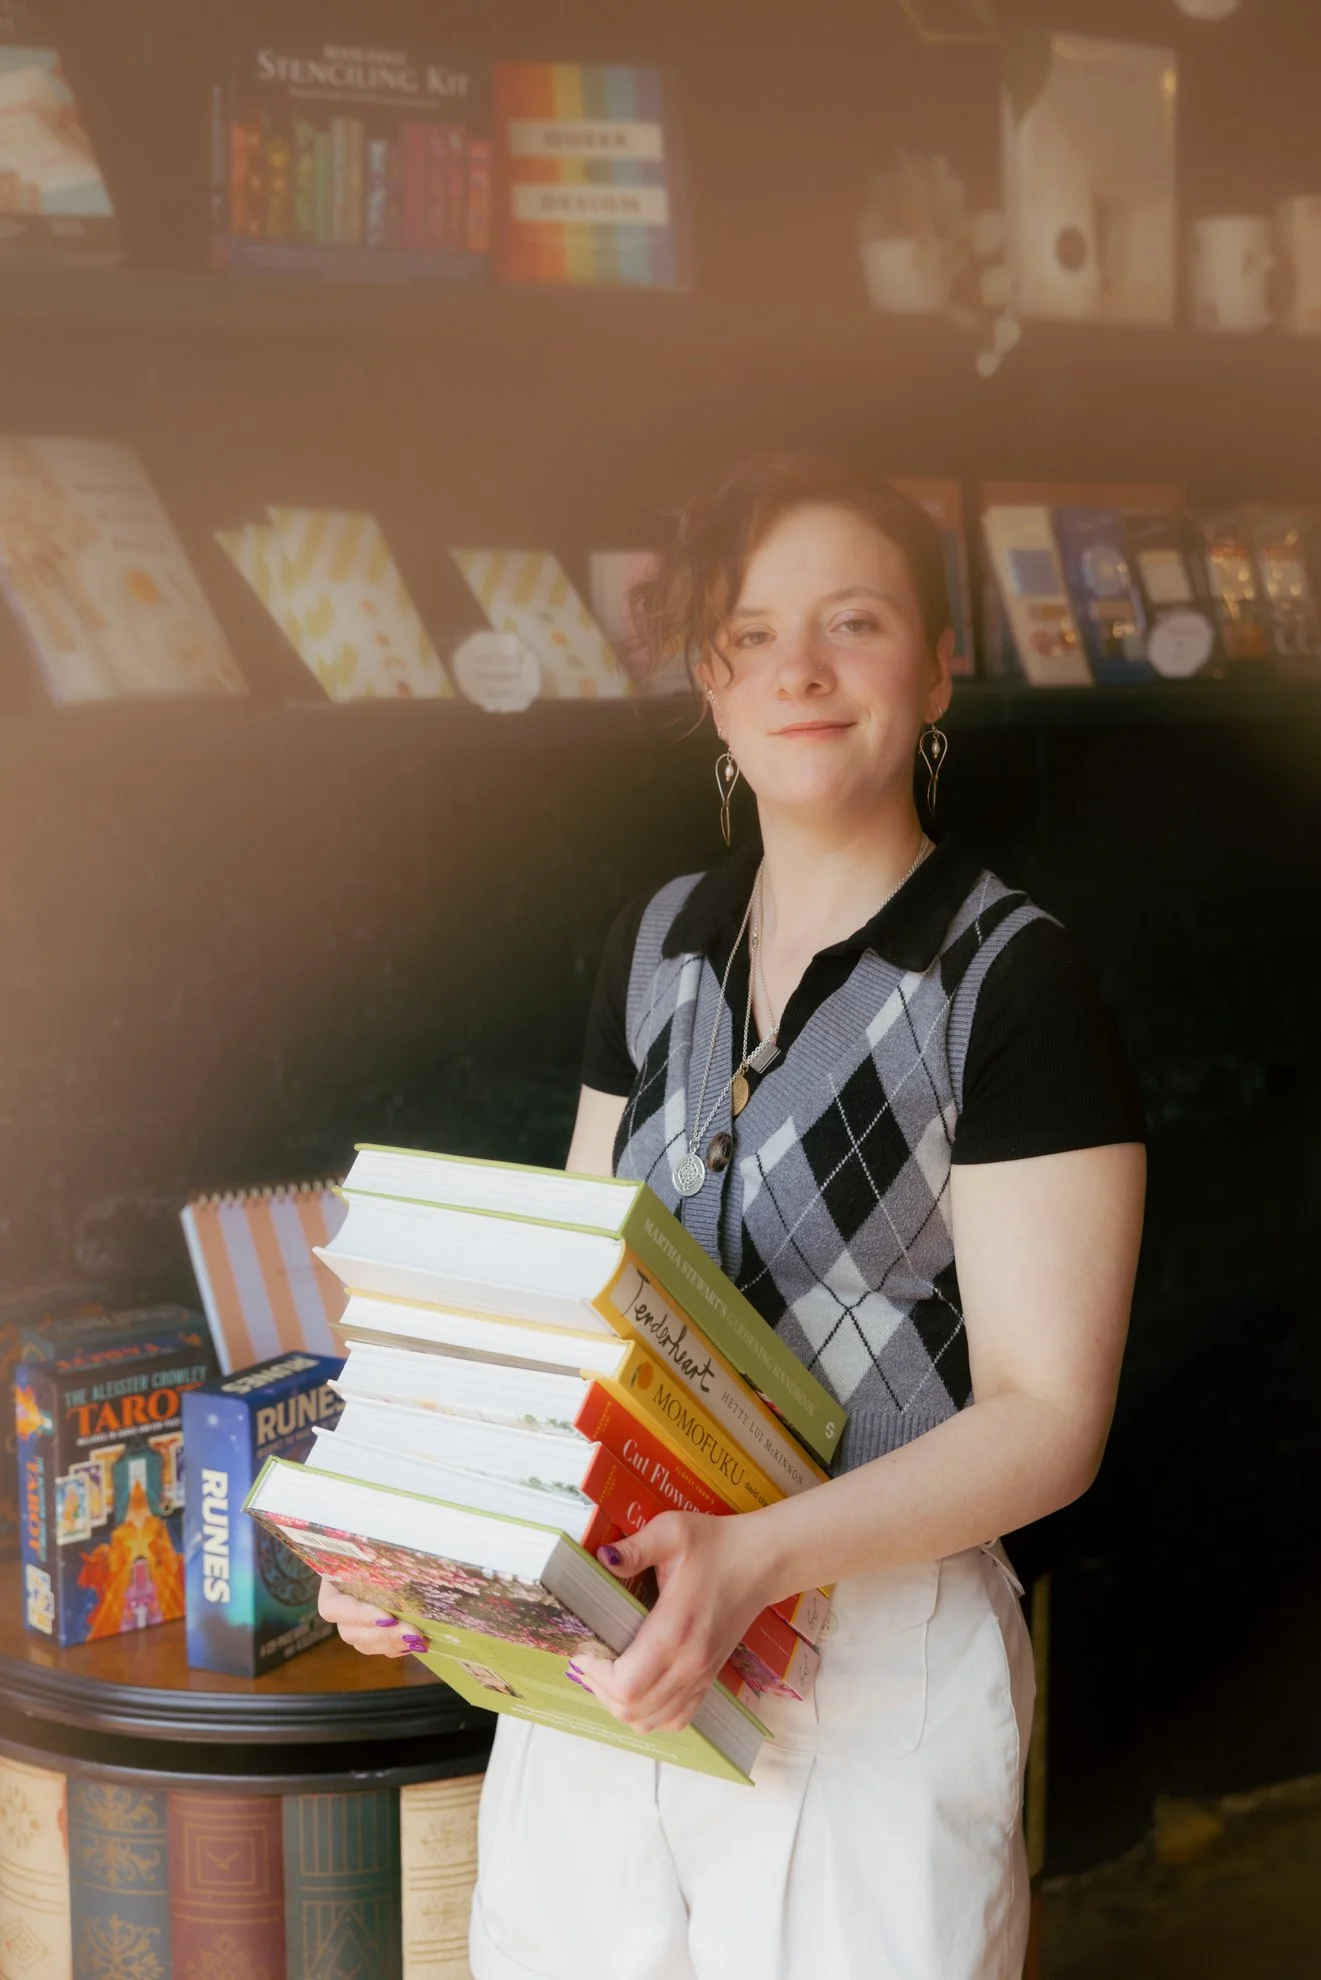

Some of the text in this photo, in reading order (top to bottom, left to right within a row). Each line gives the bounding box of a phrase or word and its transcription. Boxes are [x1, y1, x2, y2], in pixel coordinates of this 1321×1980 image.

[621, 1269, 716, 1393] Tenderheart
[643, 1218, 682, 1267] MARTHA
[771, 1361, 818, 1418] HANDBOOK
[623, 1439, 650, 1476] Cut
[652, 1384, 745, 1485] MOMOFUKU
[721, 1390, 804, 1486] HETTY LUI McKINNON
[201, 1468, 231, 1604] RUNES
[626, 1501, 647, 1530] Cu
